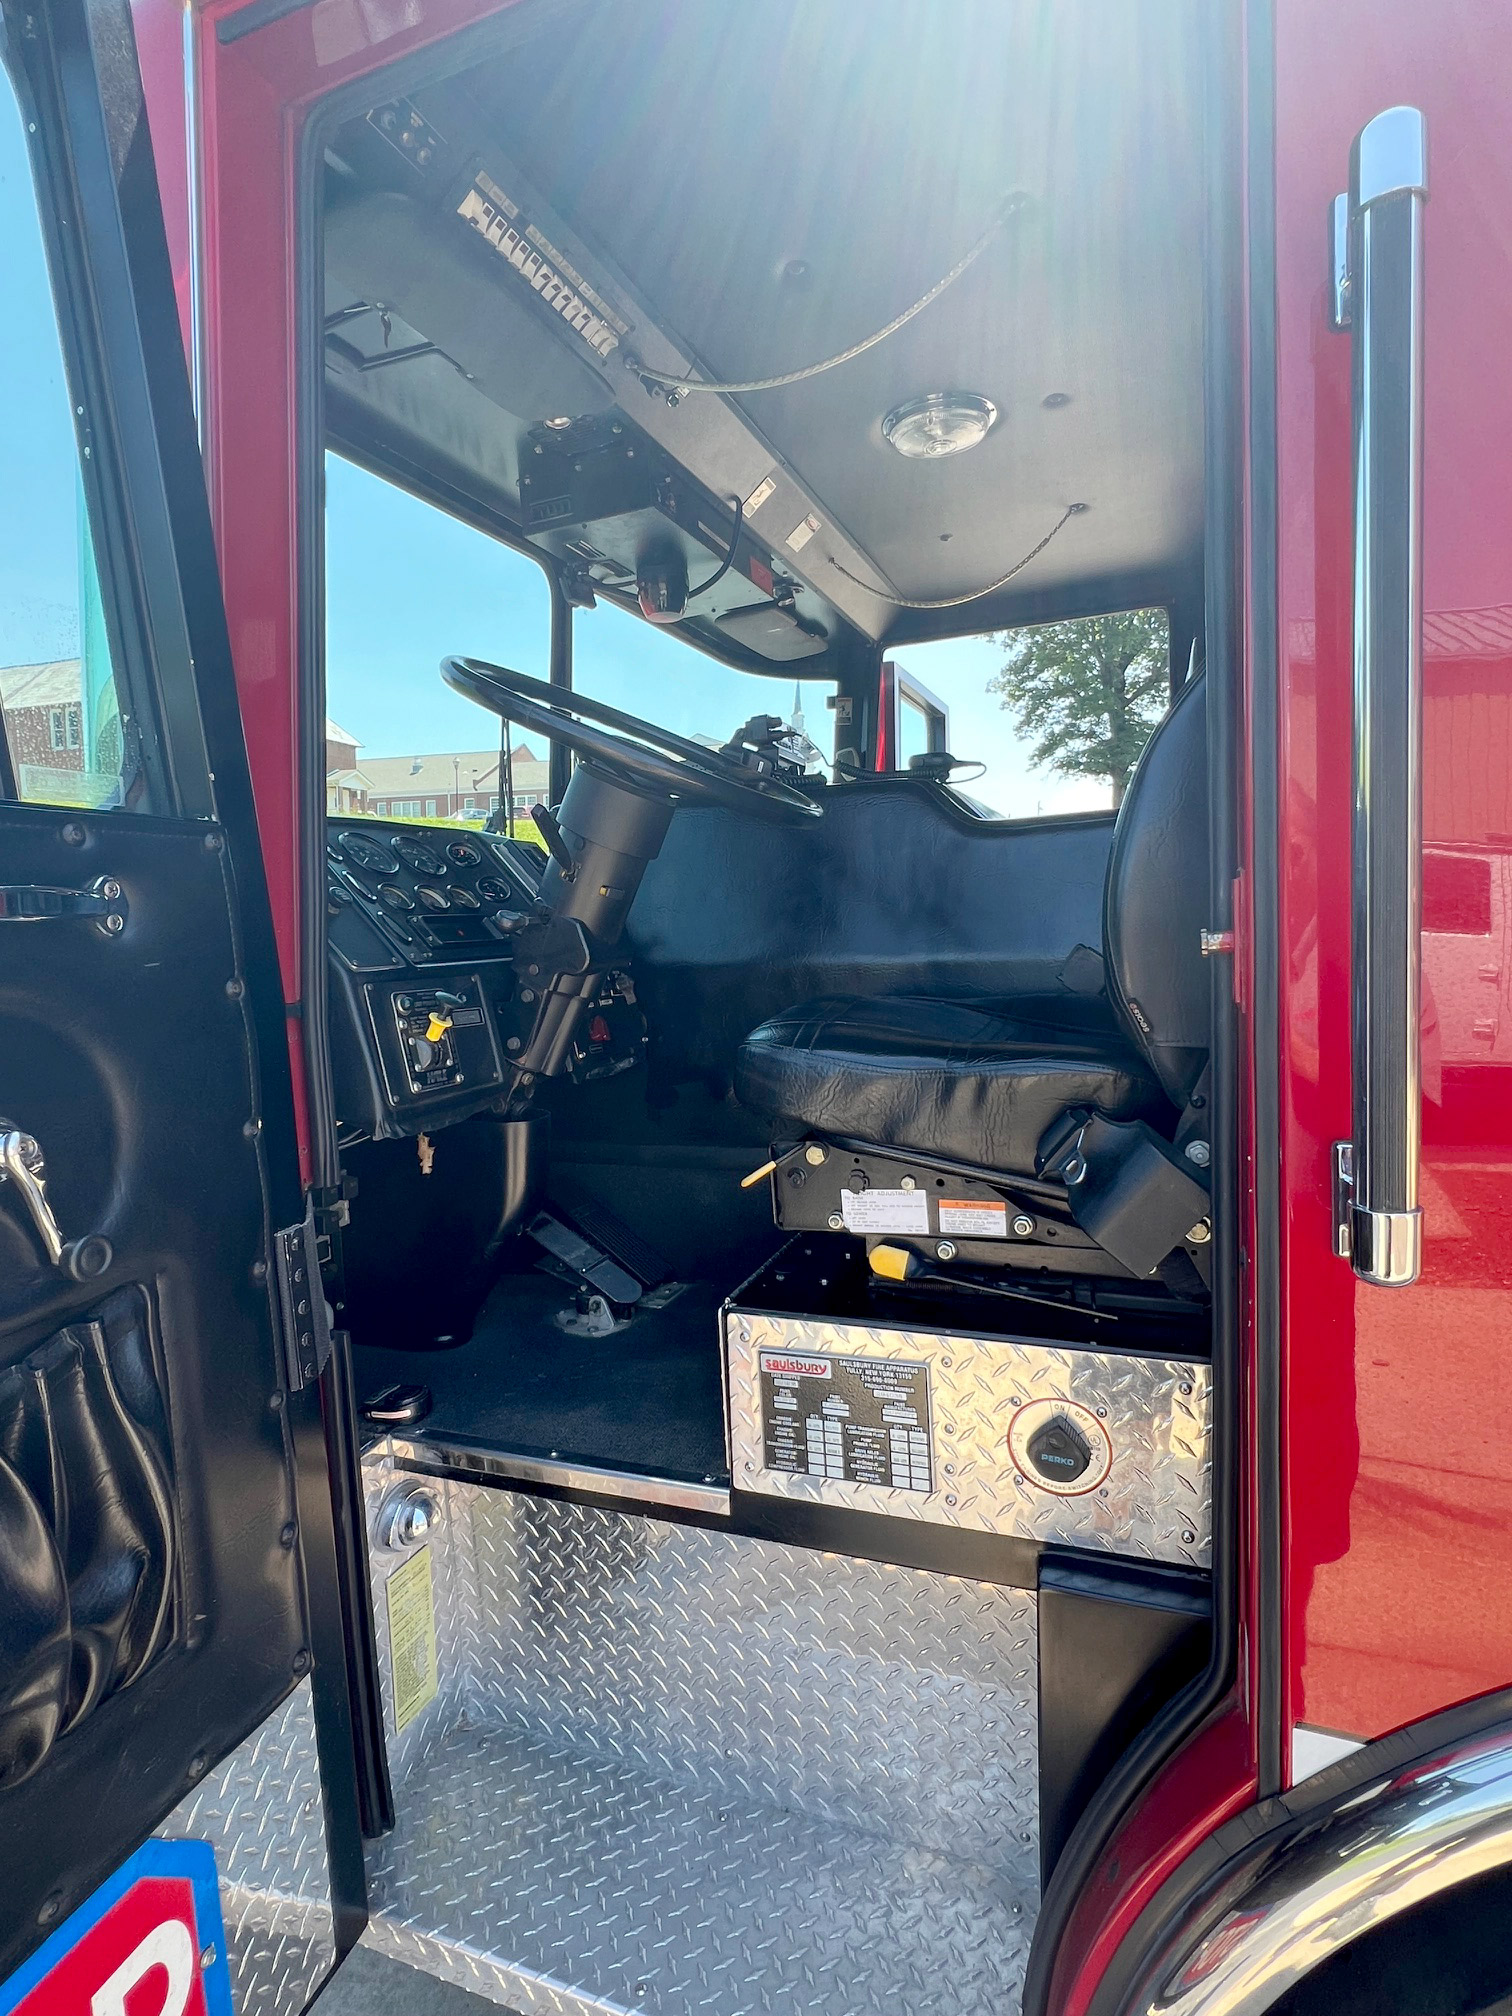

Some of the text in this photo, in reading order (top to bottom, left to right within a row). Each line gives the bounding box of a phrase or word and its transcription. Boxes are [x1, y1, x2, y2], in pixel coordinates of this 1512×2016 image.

[886, 1366, 919, 1374] APPARATUS
[1075, 1411, 1089, 1422] OFF
[1041, 1454, 1074, 1466] PERKO
